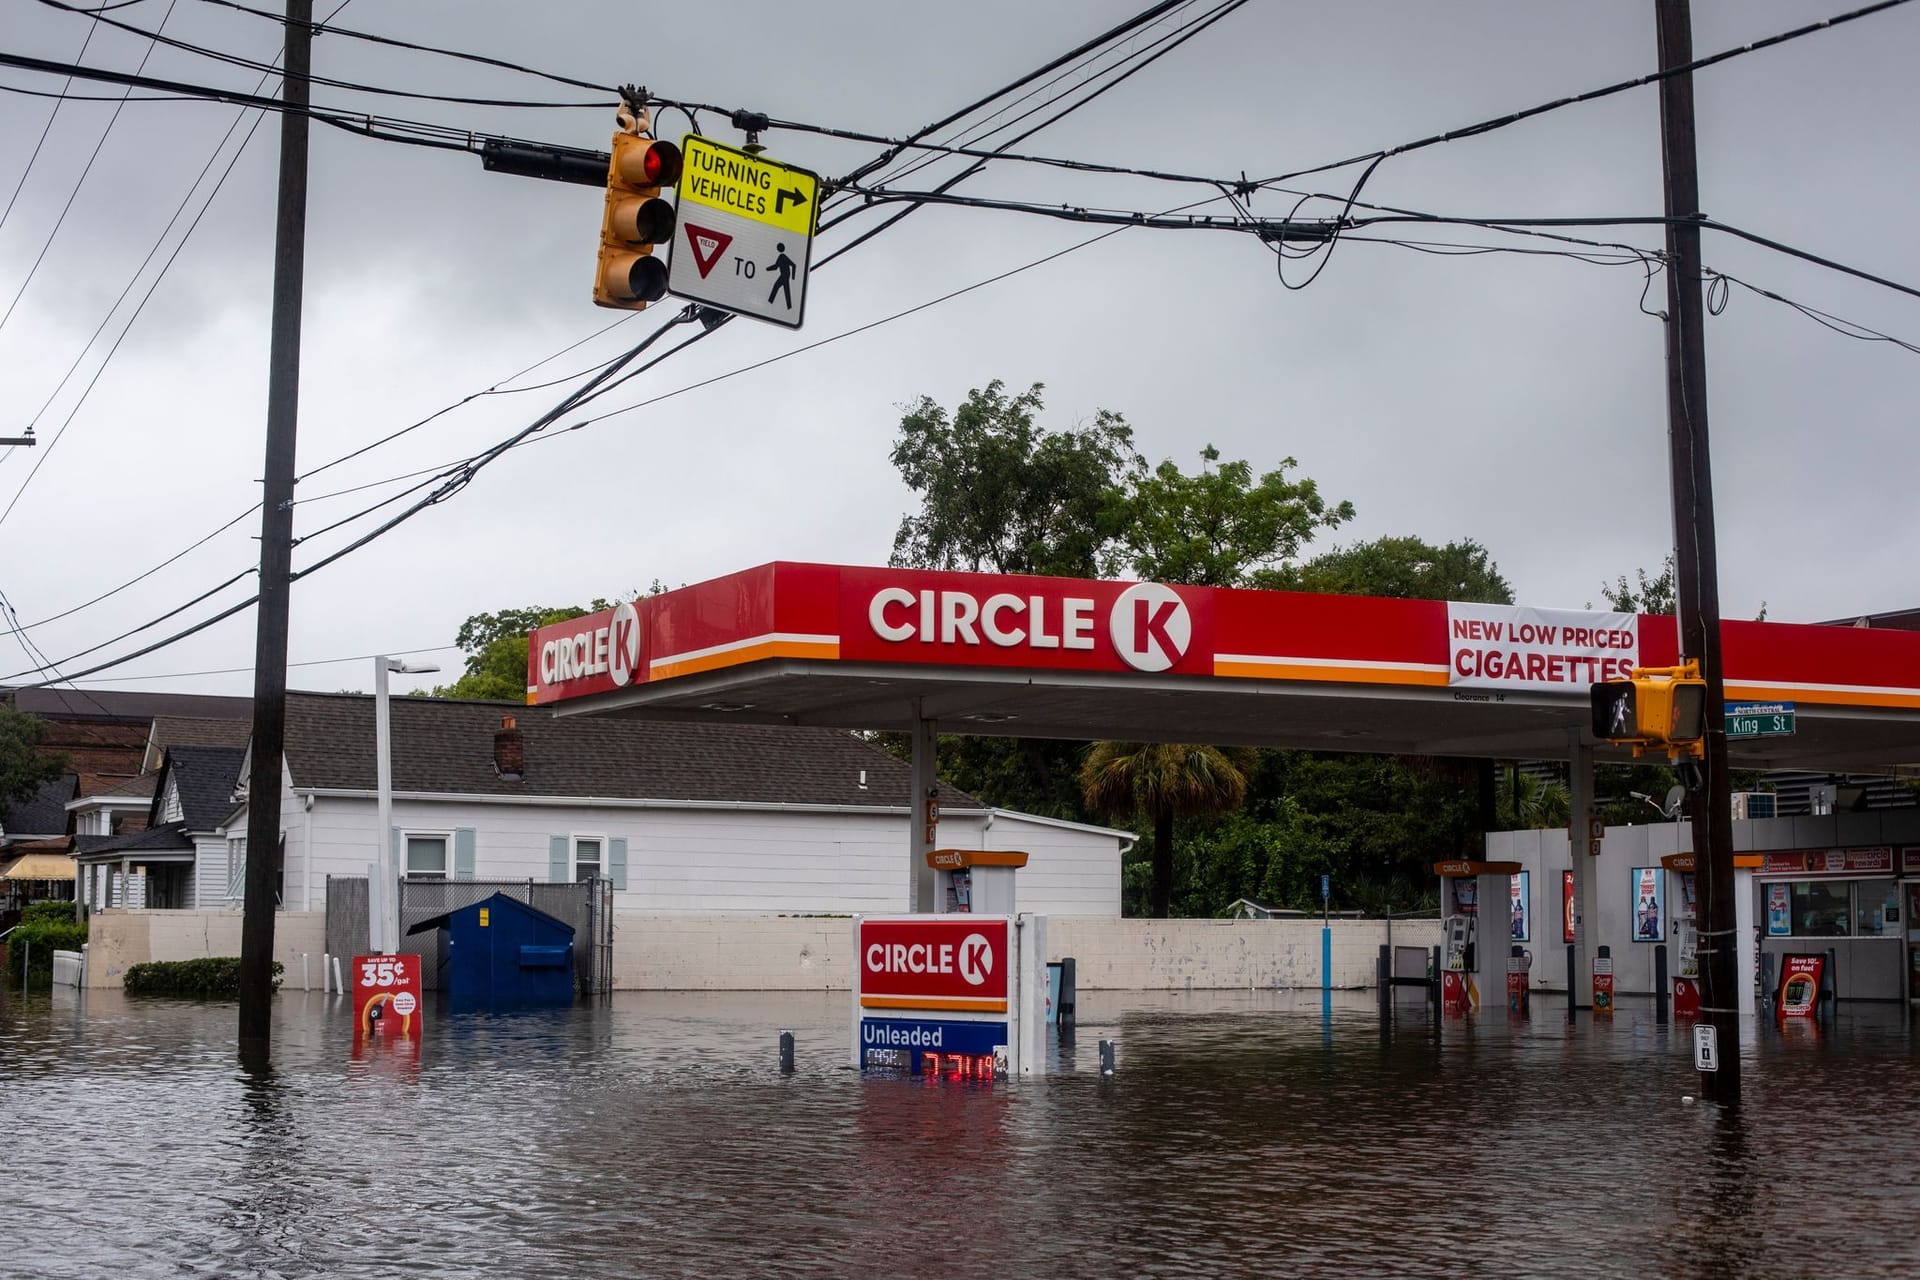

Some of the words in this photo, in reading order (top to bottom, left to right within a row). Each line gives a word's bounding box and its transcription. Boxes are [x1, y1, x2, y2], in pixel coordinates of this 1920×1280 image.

[692, 148, 771, 190] TURNING
[690, 175, 767, 215] VEHICLES
[700, 238, 716, 250] YIELD
[734, 256, 756, 279] TO
[868, 587, 1095, 650] CIRCLE
[1130, 596, 1183, 667] K
[1453, 619, 1503, 641] NEW
[1508, 623, 1557, 645] LOW
[1562, 627, 1634, 649] PRICED
[541, 627, 609, 685] CIRCLE
[1455, 648, 1634, 683] CIGARETTES
[1454, 691, 1490, 702] Clearance
[1733, 716, 1758, 733] King
[1773, 715, 1785, 731] St
[936, 854, 954, 864] CIRCLE
[1673, 920, 1679, 935] 2
[361, 961, 404, 987] 35¢
[866, 943, 953, 974] CIRCLE
[967, 942, 990, 982] K
[863, 1024, 943, 1047] Unleaded
